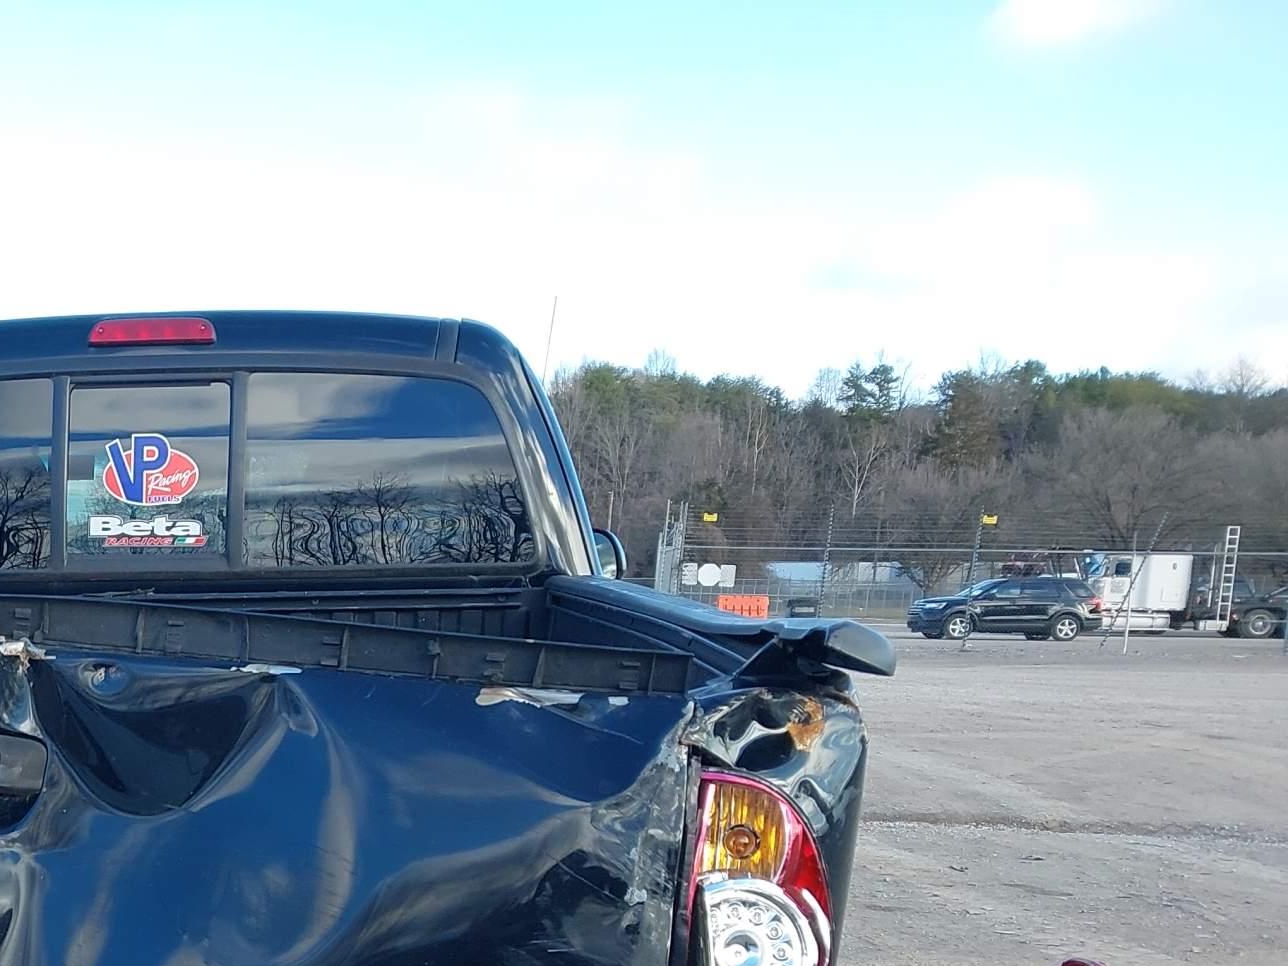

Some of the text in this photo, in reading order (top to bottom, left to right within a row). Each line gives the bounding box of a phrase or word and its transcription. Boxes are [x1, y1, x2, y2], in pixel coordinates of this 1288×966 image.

[105, 433, 170, 504] VP
[147, 469, 195, 495] Racing
[89, 515, 202, 536] Beta
[105, 536, 174, 546] RACING
